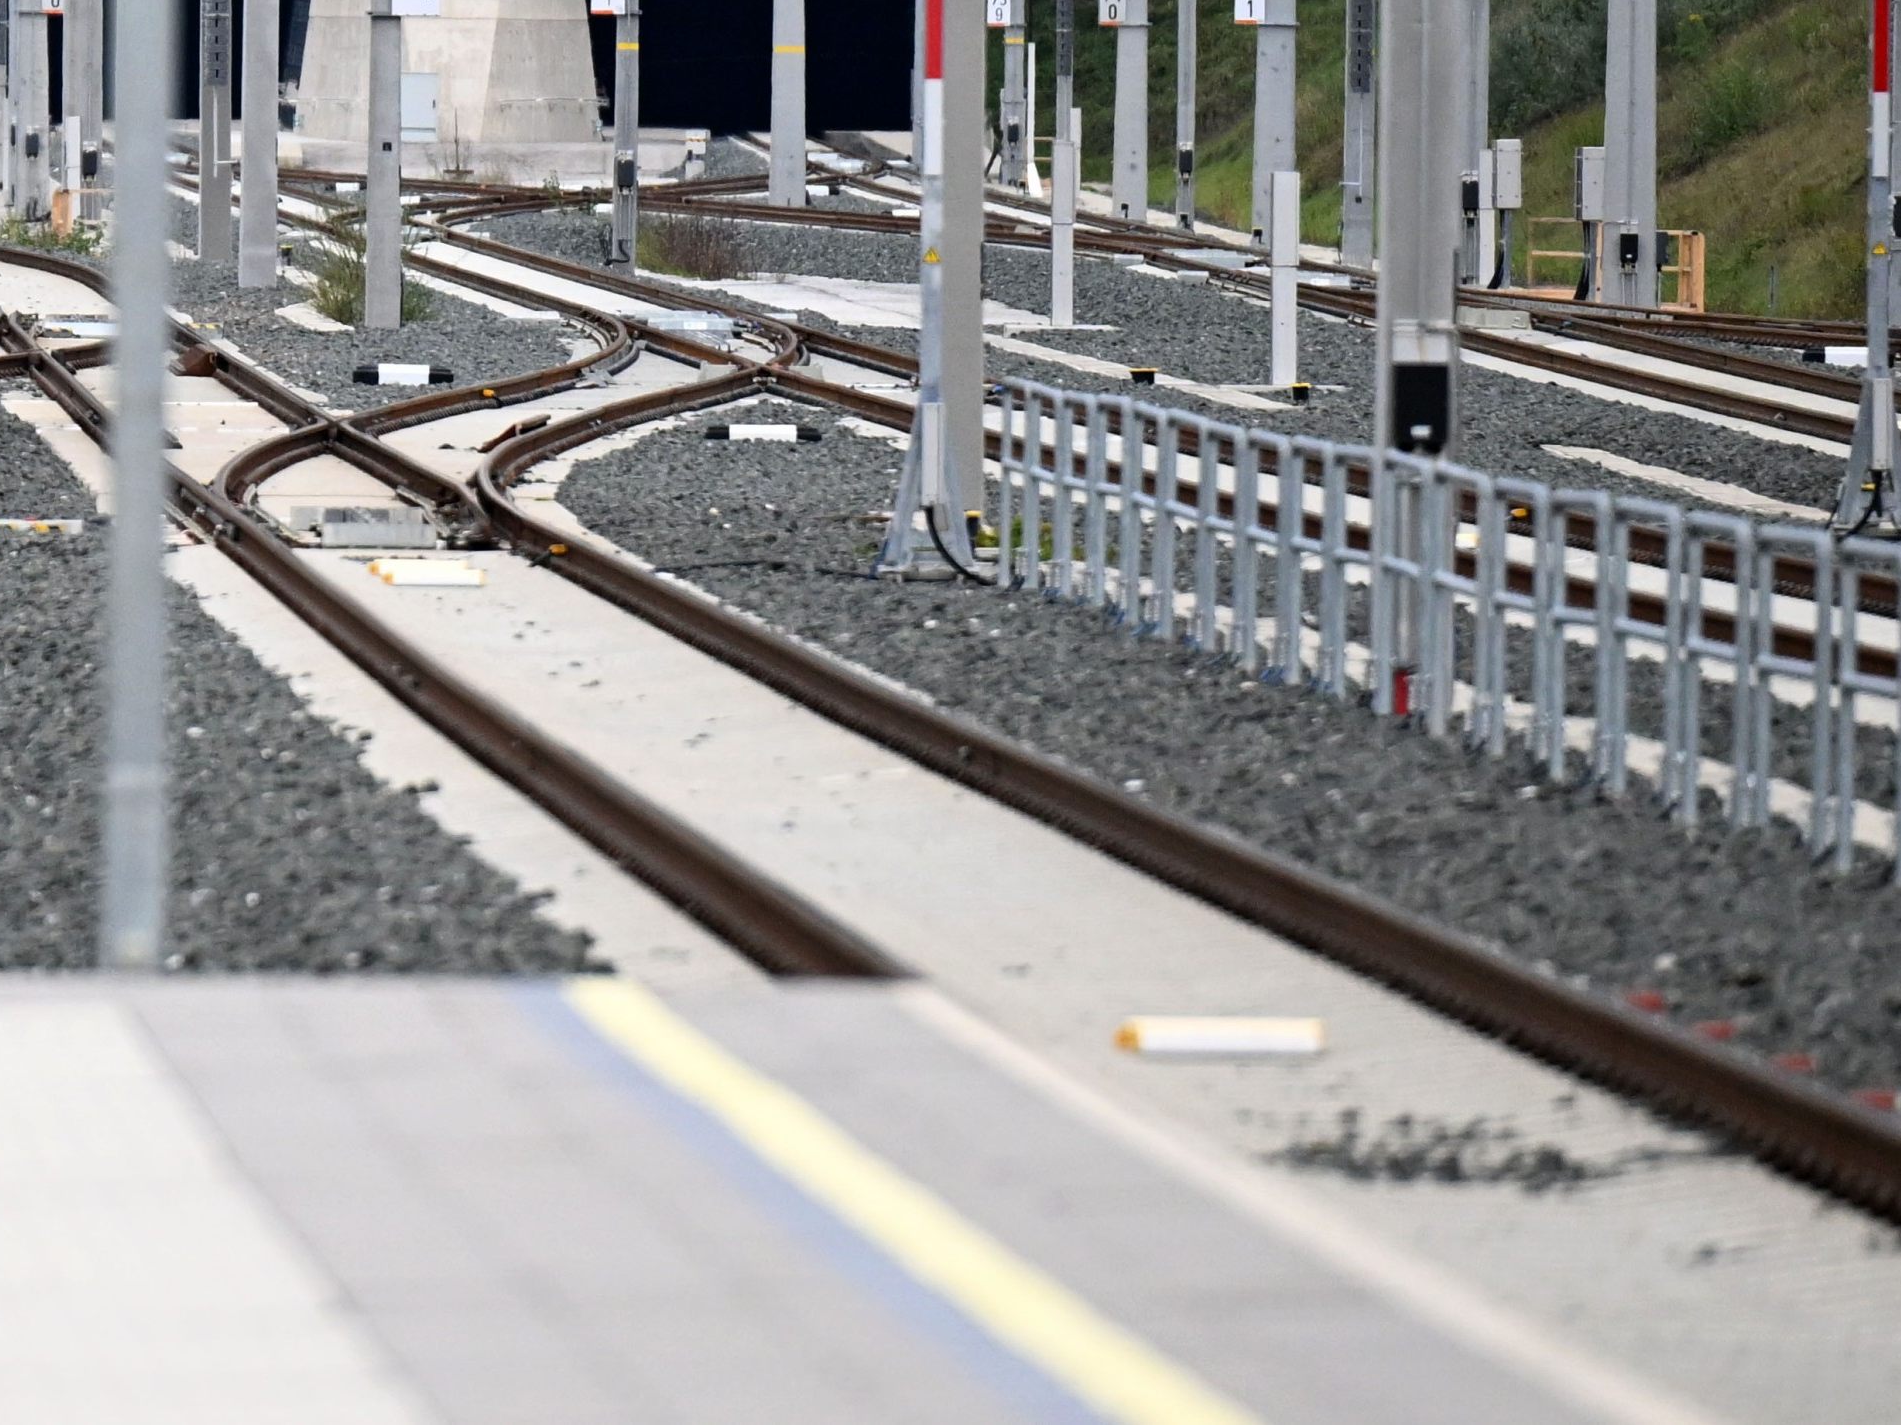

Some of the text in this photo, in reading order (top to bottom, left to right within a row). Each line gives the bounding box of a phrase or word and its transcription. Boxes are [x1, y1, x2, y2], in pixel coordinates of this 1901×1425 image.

[995, 7, 1003, 21] 9
[1108, 5, 1117, 20] 0
[1247, 0, 1253, 18] 1
